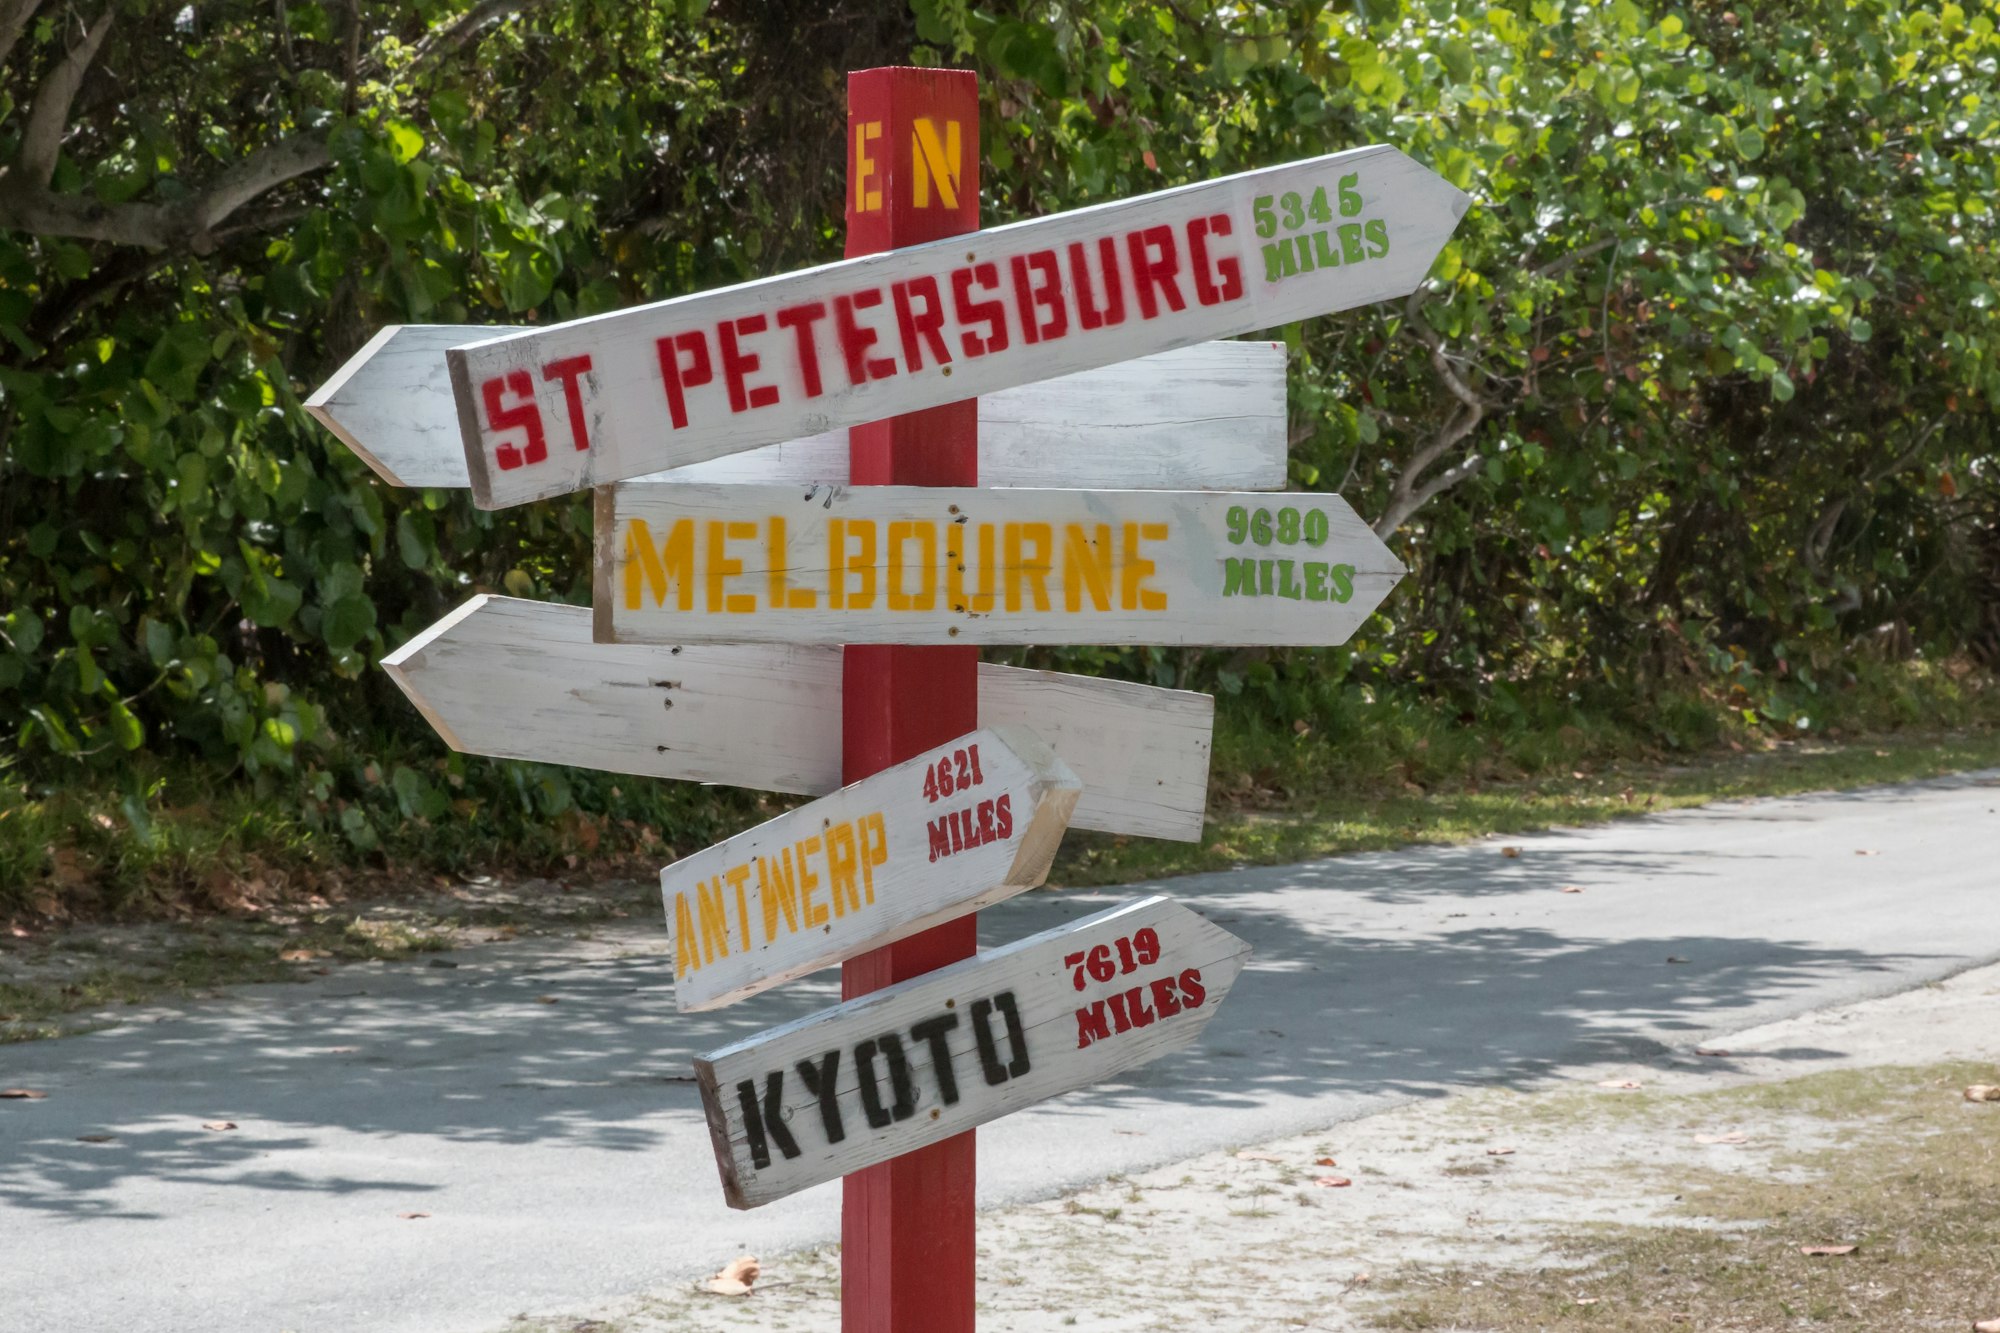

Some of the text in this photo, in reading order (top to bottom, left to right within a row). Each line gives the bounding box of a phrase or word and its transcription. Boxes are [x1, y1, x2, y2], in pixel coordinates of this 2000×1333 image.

[856, 121, 882, 213] E
[912, 117, 961, 209] N
[1253, 172, 1363, 238] 5345
[1261, 219, 1390, 283] MILES
[481, 213, 1244, 471] ST PETERSBURG
[624, 515, 1168, 613] MELBOURNE
[1226, 505, 1329, 547] 9680
[1223, 557, 1356, 603] MILES
[922, 744, 984, 803] 4621
[927, 793, 1013, 863] MILES
[674, 811, 888, 980] ANTWERP
[1064, 927, 1161, 991] 7619
[1076, 967, 1206, 1049] MILES
[736, 991, 1030, 1170] KYOTO
